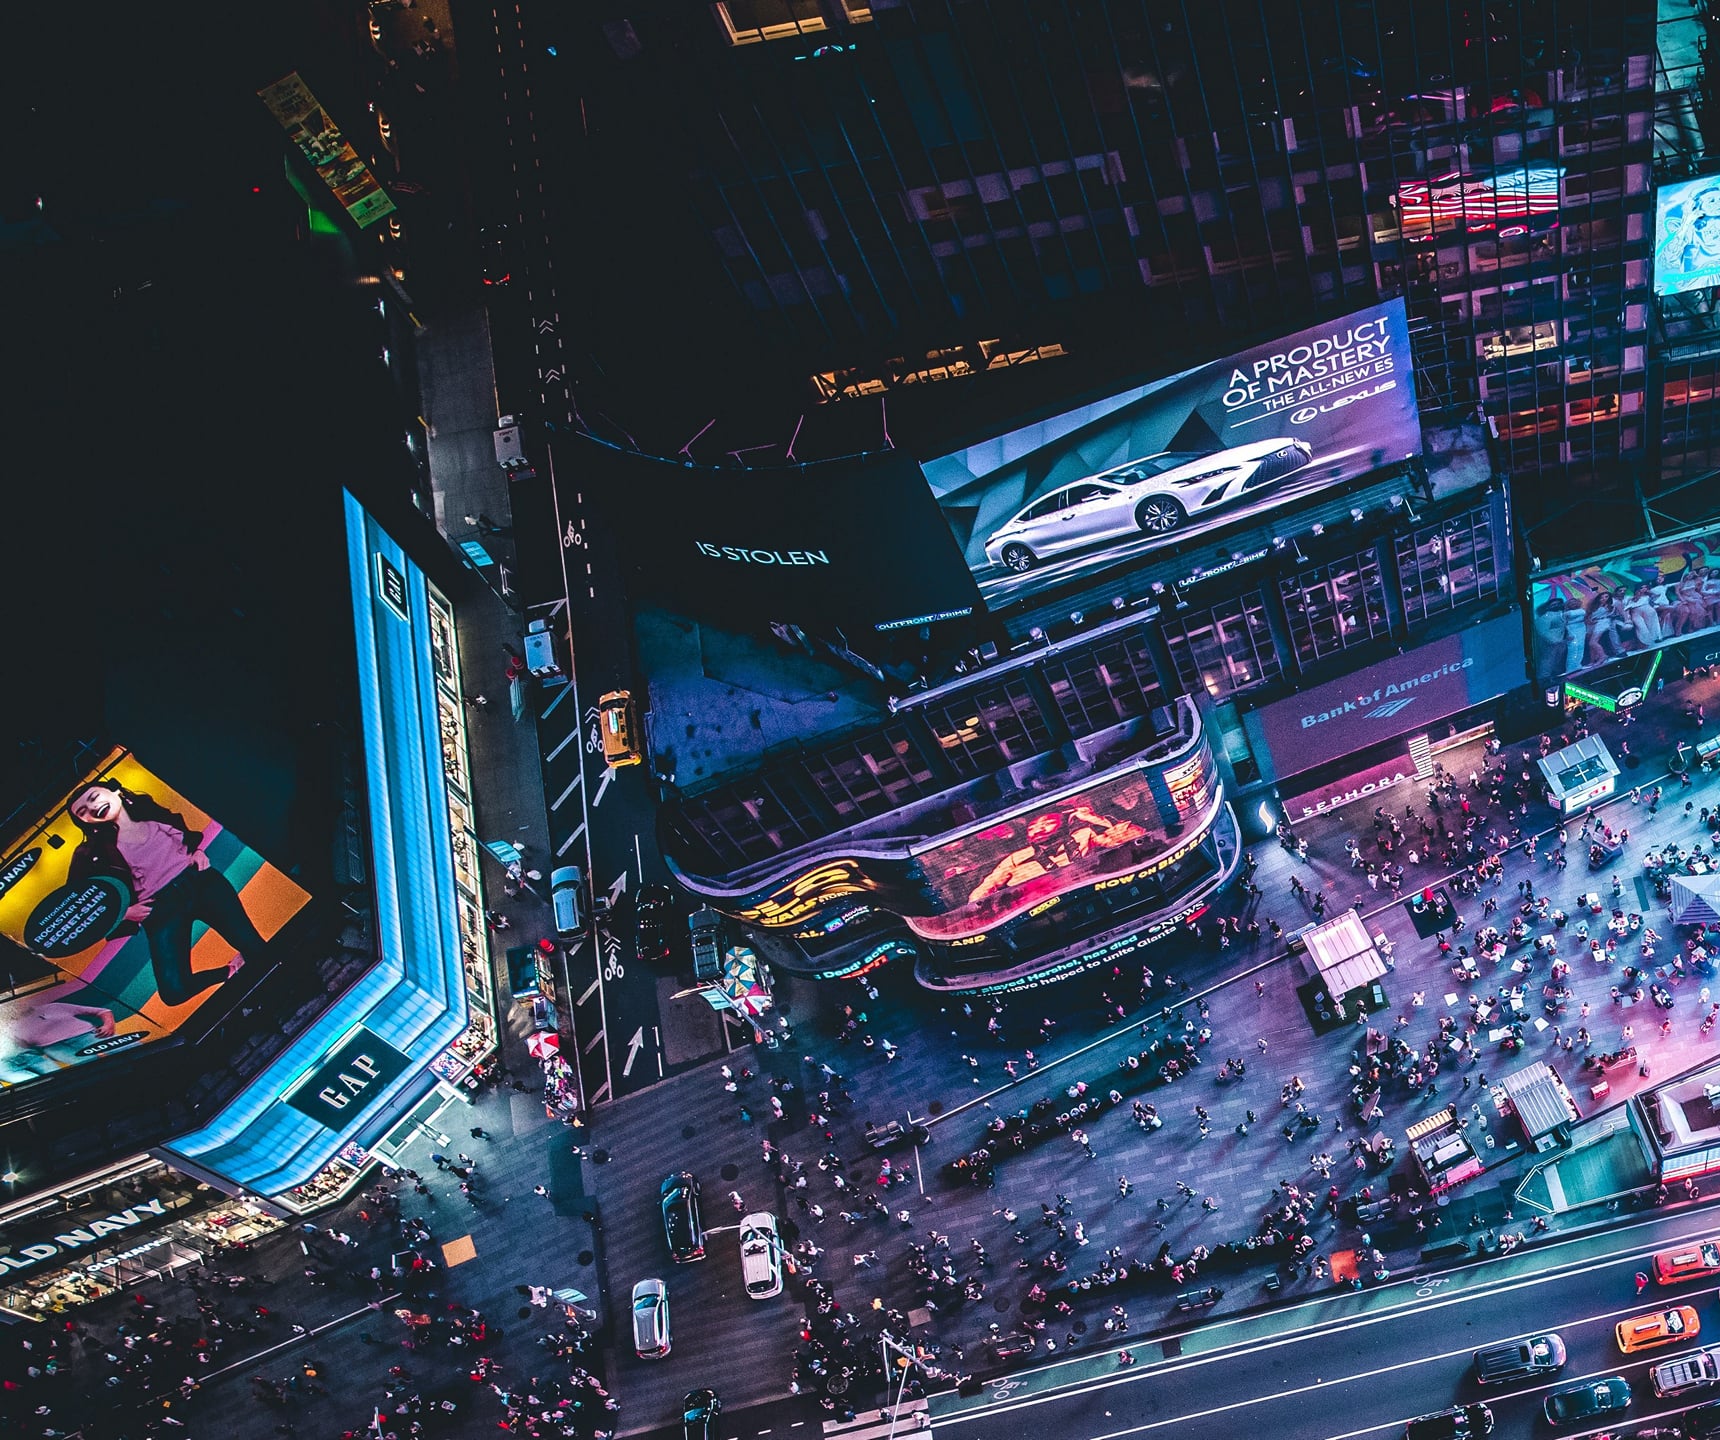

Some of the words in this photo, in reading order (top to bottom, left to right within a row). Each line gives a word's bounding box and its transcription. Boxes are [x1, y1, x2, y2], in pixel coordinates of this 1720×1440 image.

[1229, 369, 1249, 388] A
[1253, 316, 1389, 378] PRODUCT
[1222, 381, 1261, 407] OF
[1268, 335, 1391, 393] MASTERY
[1263, 392, 1296, 412] THE
[1298, 366, 1370, 400] ALL-NEW
[1375, 357, 1394, 373] ES
[1319, 380, 1397, 413] LEXUS
[695, 541, 721, 557] IS
[721, 547, 830, 565] STOLEN
[1301, 702, 1357, 729] Bank
[1359, 689, 1381, 706] of
[1384, 657, 1474, 698] America
[1303, 773, 1405, 817] SEPHORA
[3, 853, 34, 882] NAVY
[1094, 874, 1136, 891] NOW
[1138, 866, 1157, 878] ON
[34, 904, 78, 943] ROCKSTAR
[75, 884, 98, 905] WITH
[43, 890, 107, 949] SECRET-SLIM
[61, 905, 107, 946] POCKETS
[1160, 900, 1205, 929] NEWS
[864, 941, 895, 963] actor
[951, 935, 986, 946] AND
[1083, 949, 1107, 961] has
[1110, 935, 1138, 951] died
[83, 1044, 108, 1055] OLD
[108, 1033, 141, 1047] NAVY
[320, 1054, 380, 1109] GAP
[54, 1199, 166, 1248] NAVY
[87, 1257, 120, 1272] OLD
[118, 1239, 162, 1260] NAVY
